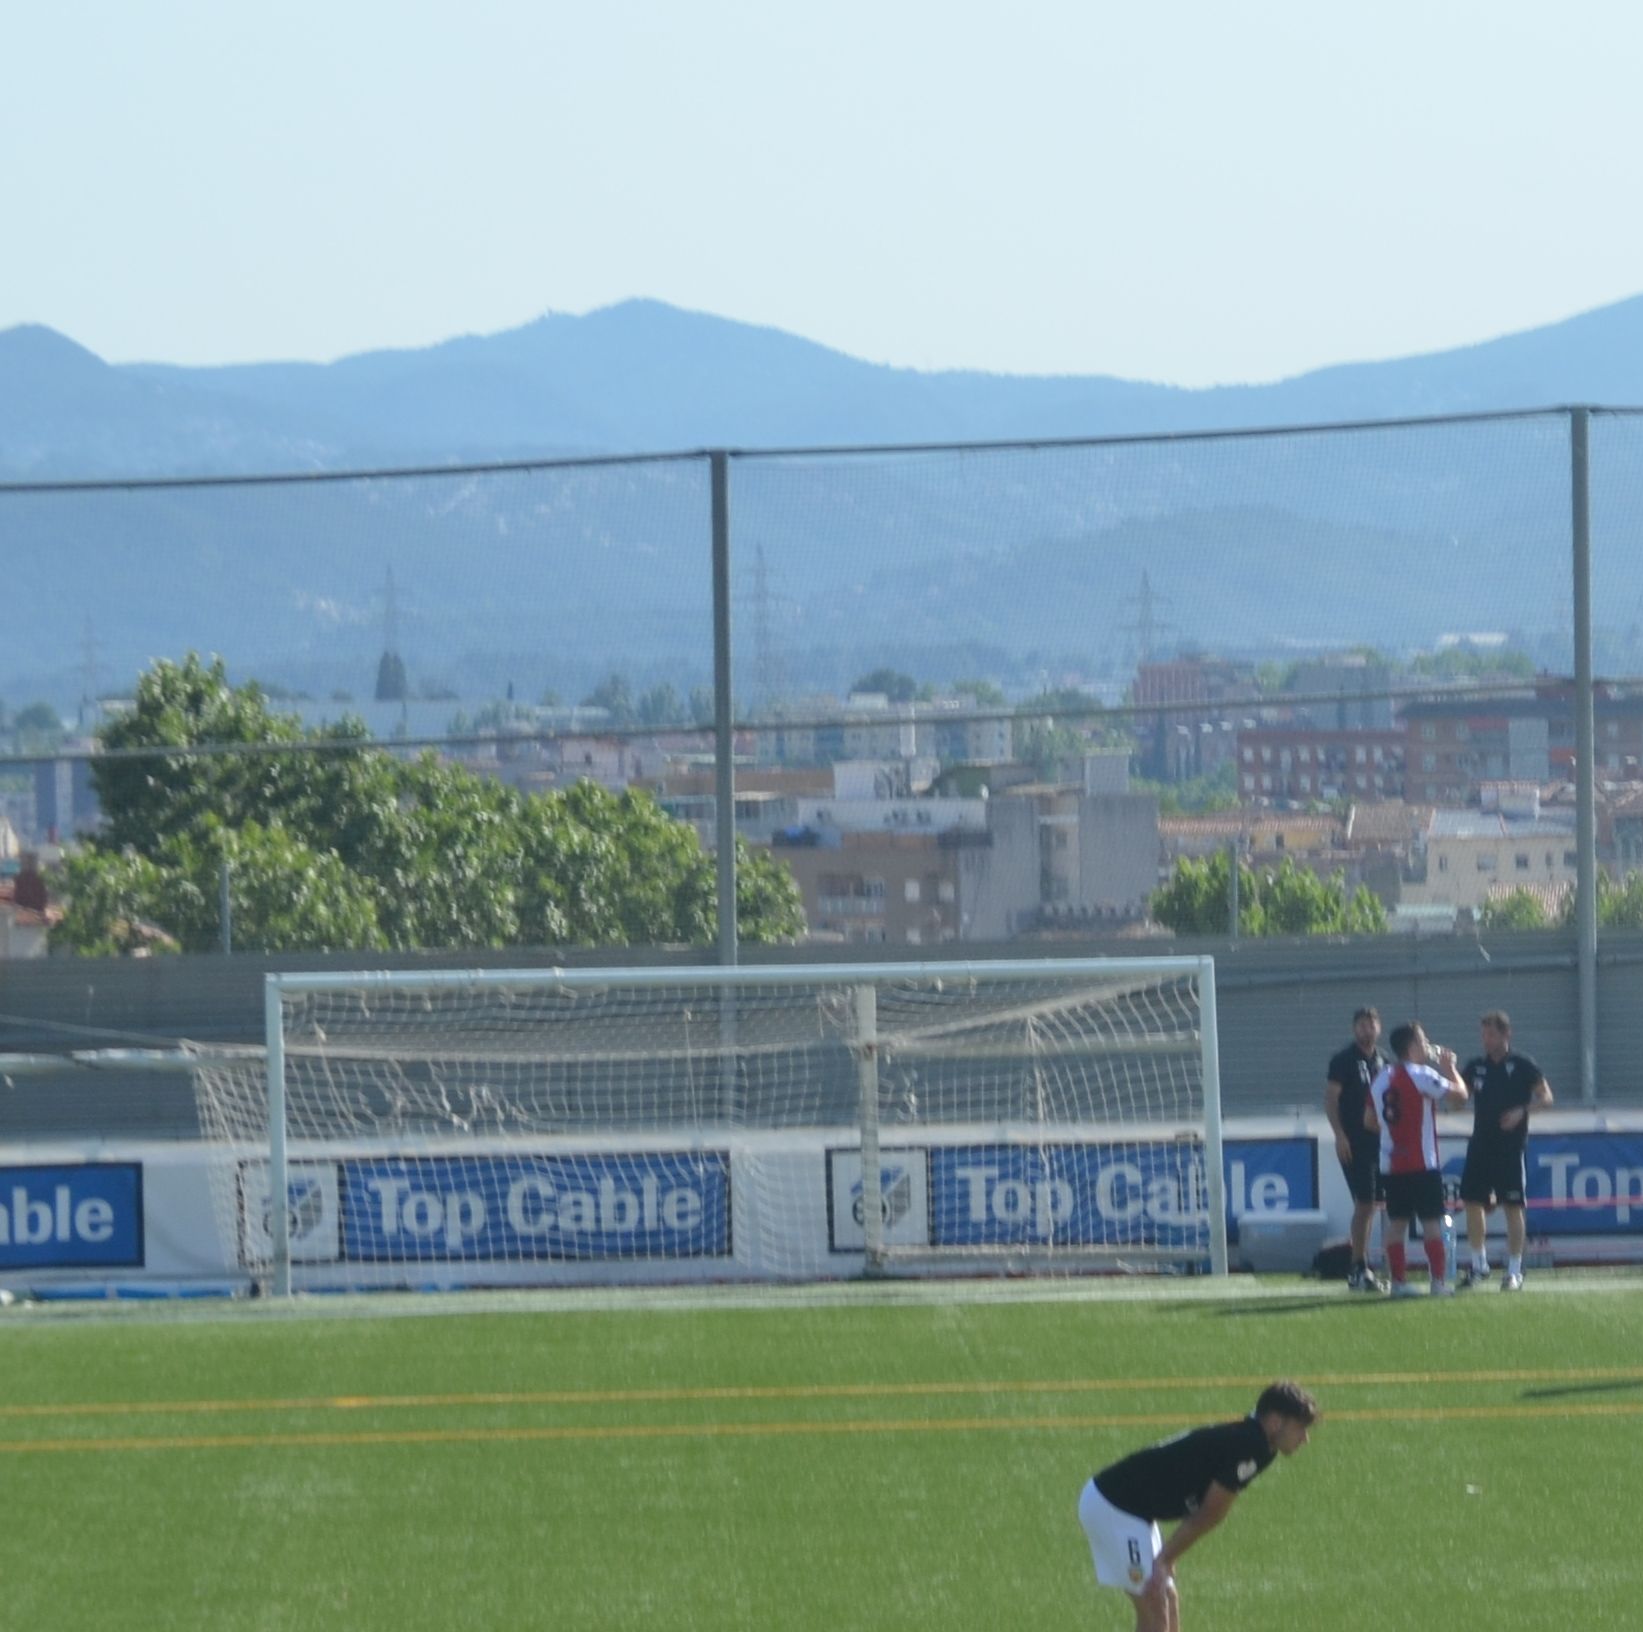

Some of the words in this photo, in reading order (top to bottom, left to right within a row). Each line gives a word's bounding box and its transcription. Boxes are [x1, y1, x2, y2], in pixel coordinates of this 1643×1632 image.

[368, 1176, 486, 1249] Top
[506, 1175, 701, 1236] Cable
[956, 1163, 1073, 1235] Top
